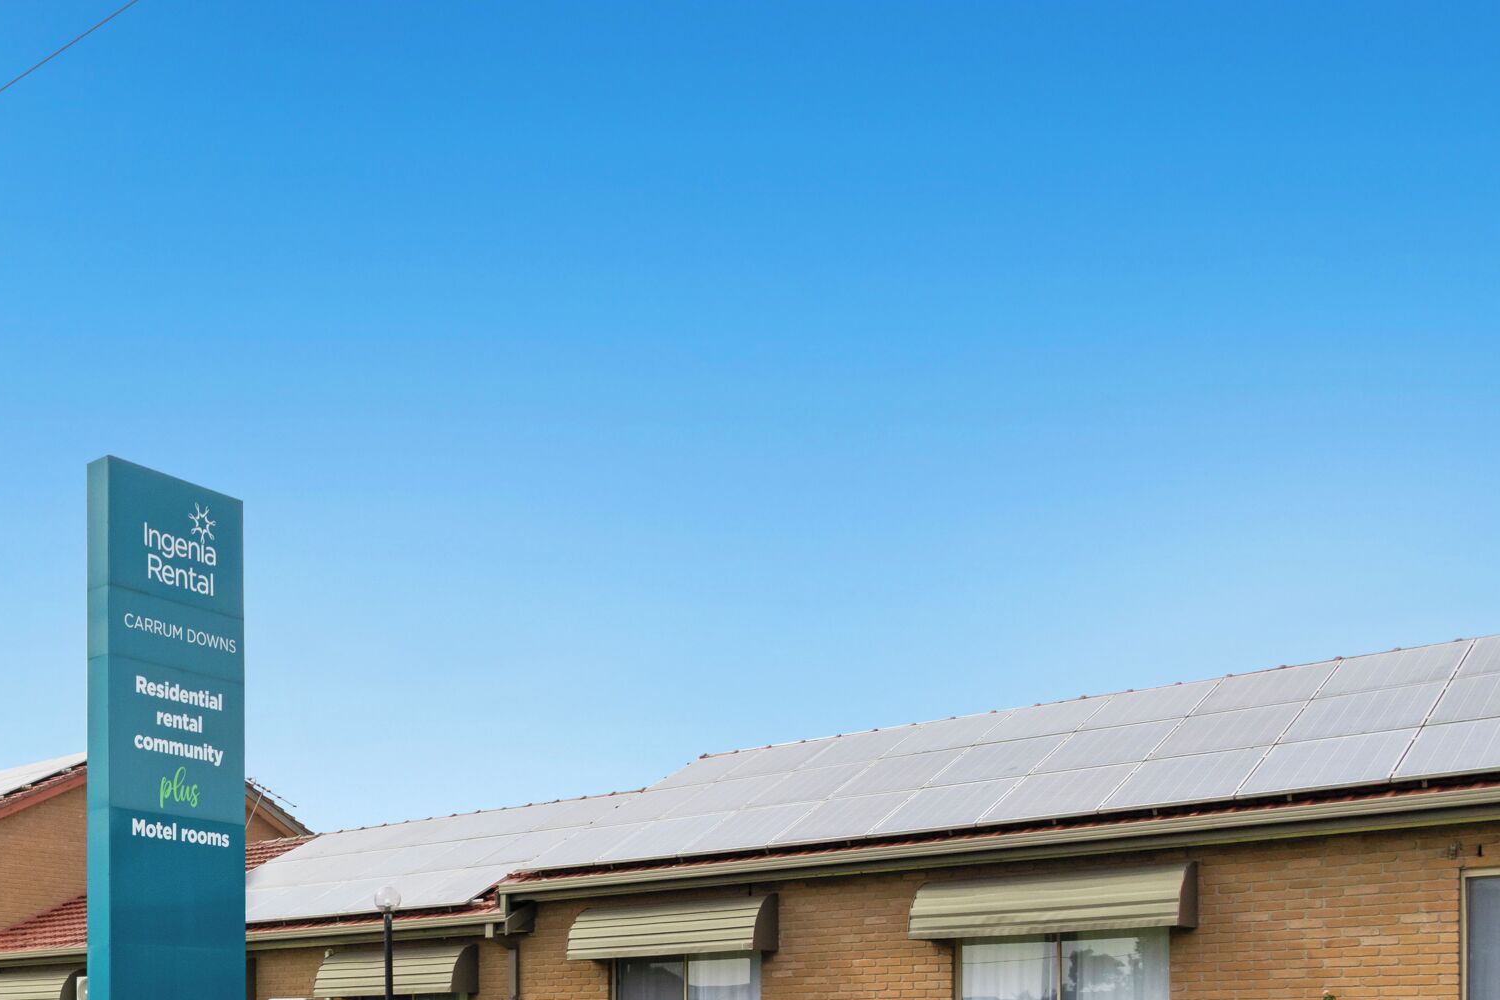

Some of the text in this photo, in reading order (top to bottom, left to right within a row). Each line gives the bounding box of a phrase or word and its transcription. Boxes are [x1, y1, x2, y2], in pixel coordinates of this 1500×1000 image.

[144, 521, 217, 566] Ingenia
[147, 553, 214, 597] Rental
[124, 613, 237, 654] CARRUM DOWNS
[135, 675, 223, 712] Residential
[156, 711, 203, 734] rental
[133, 734, 224, 767] community
[159, 766, 201, 809] plus
[131, 818, 230, 848] Motel rooms
